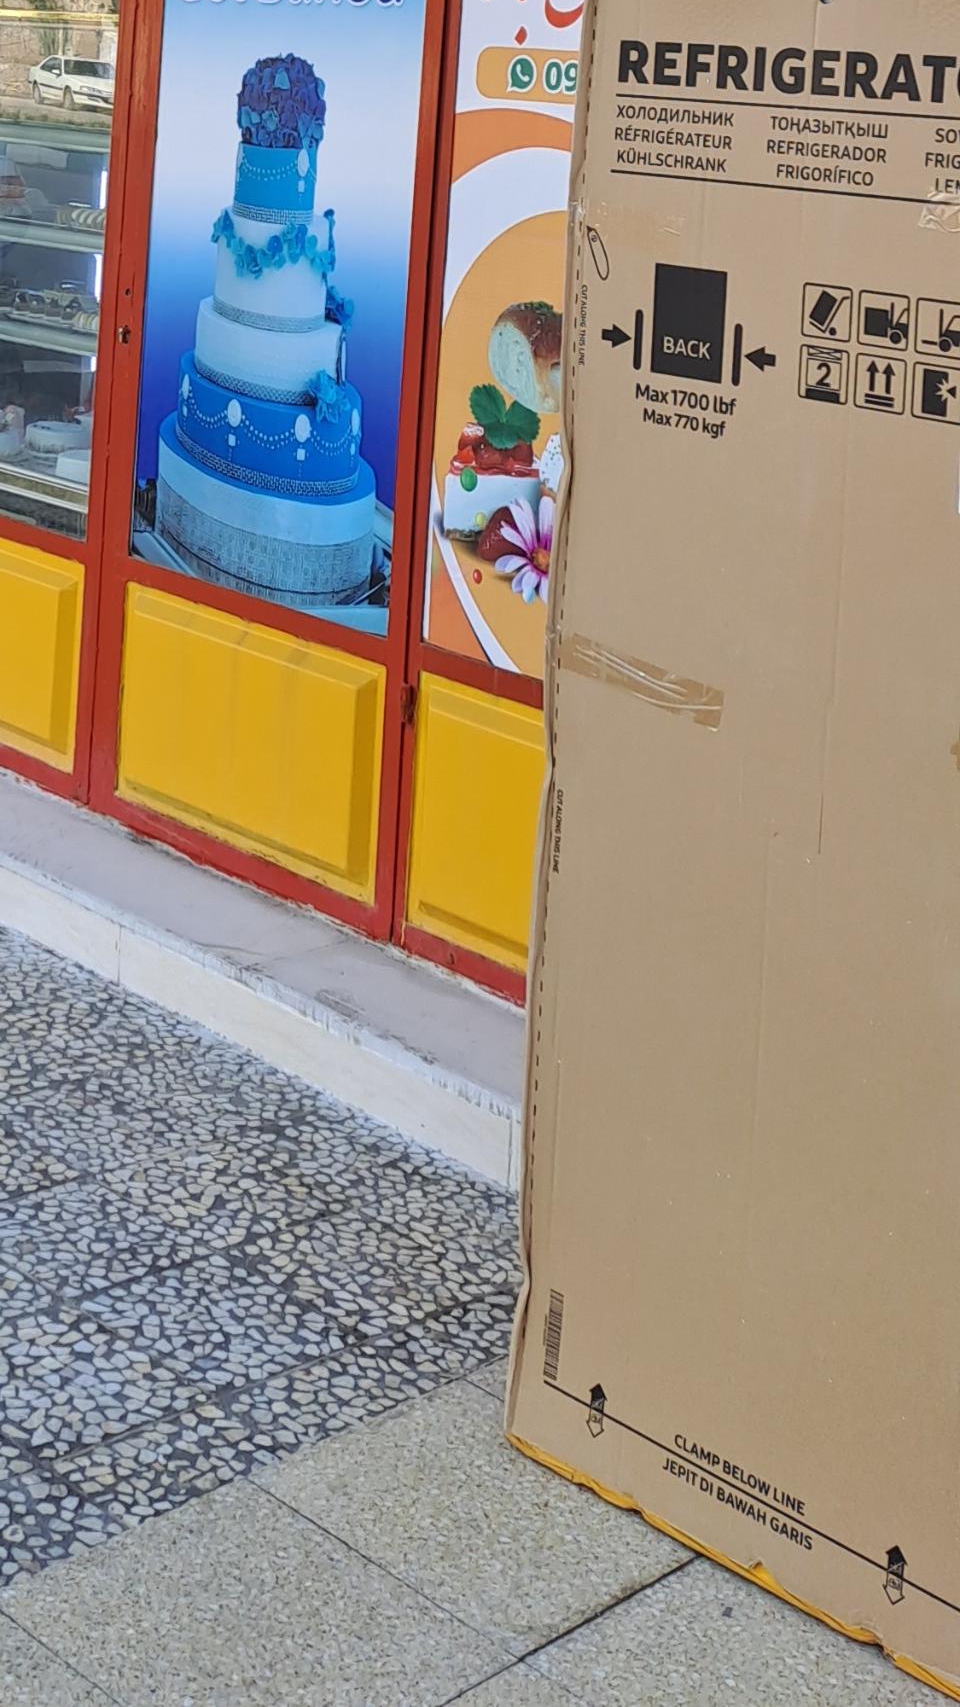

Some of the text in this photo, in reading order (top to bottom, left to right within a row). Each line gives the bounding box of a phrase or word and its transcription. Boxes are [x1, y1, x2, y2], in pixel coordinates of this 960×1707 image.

[618, 39, 960, 103] REFRIGERAT
[616, 104, 734, 127] ХОЛОДИЛЬНИК
[770, 116, 888, 139] ТОҢАЗЫТҚЫШ
[614, 125, 732, 150] RÉFRIGÉRATEUR
[935, 128, 960, 144] SO
[616, 148, 727, 173] KÜHLSCHRANK
[767, 139, 887, 163] REFRIGERADOR
[776, 163, 874, 187] FRIGORÍFICO
[663, 335, 711, 360] BACK
[815, 362, 832, 387] 2
[635, 382, 737, 415] Max 1700 lbf
[643, 407, 726, 439] Max 770 kgf
[674, 1434, 806, 1516] CLAMP BELOW LINE
[662, 1457, 813, 1551] JEPIT DI BAWAH GARIS
